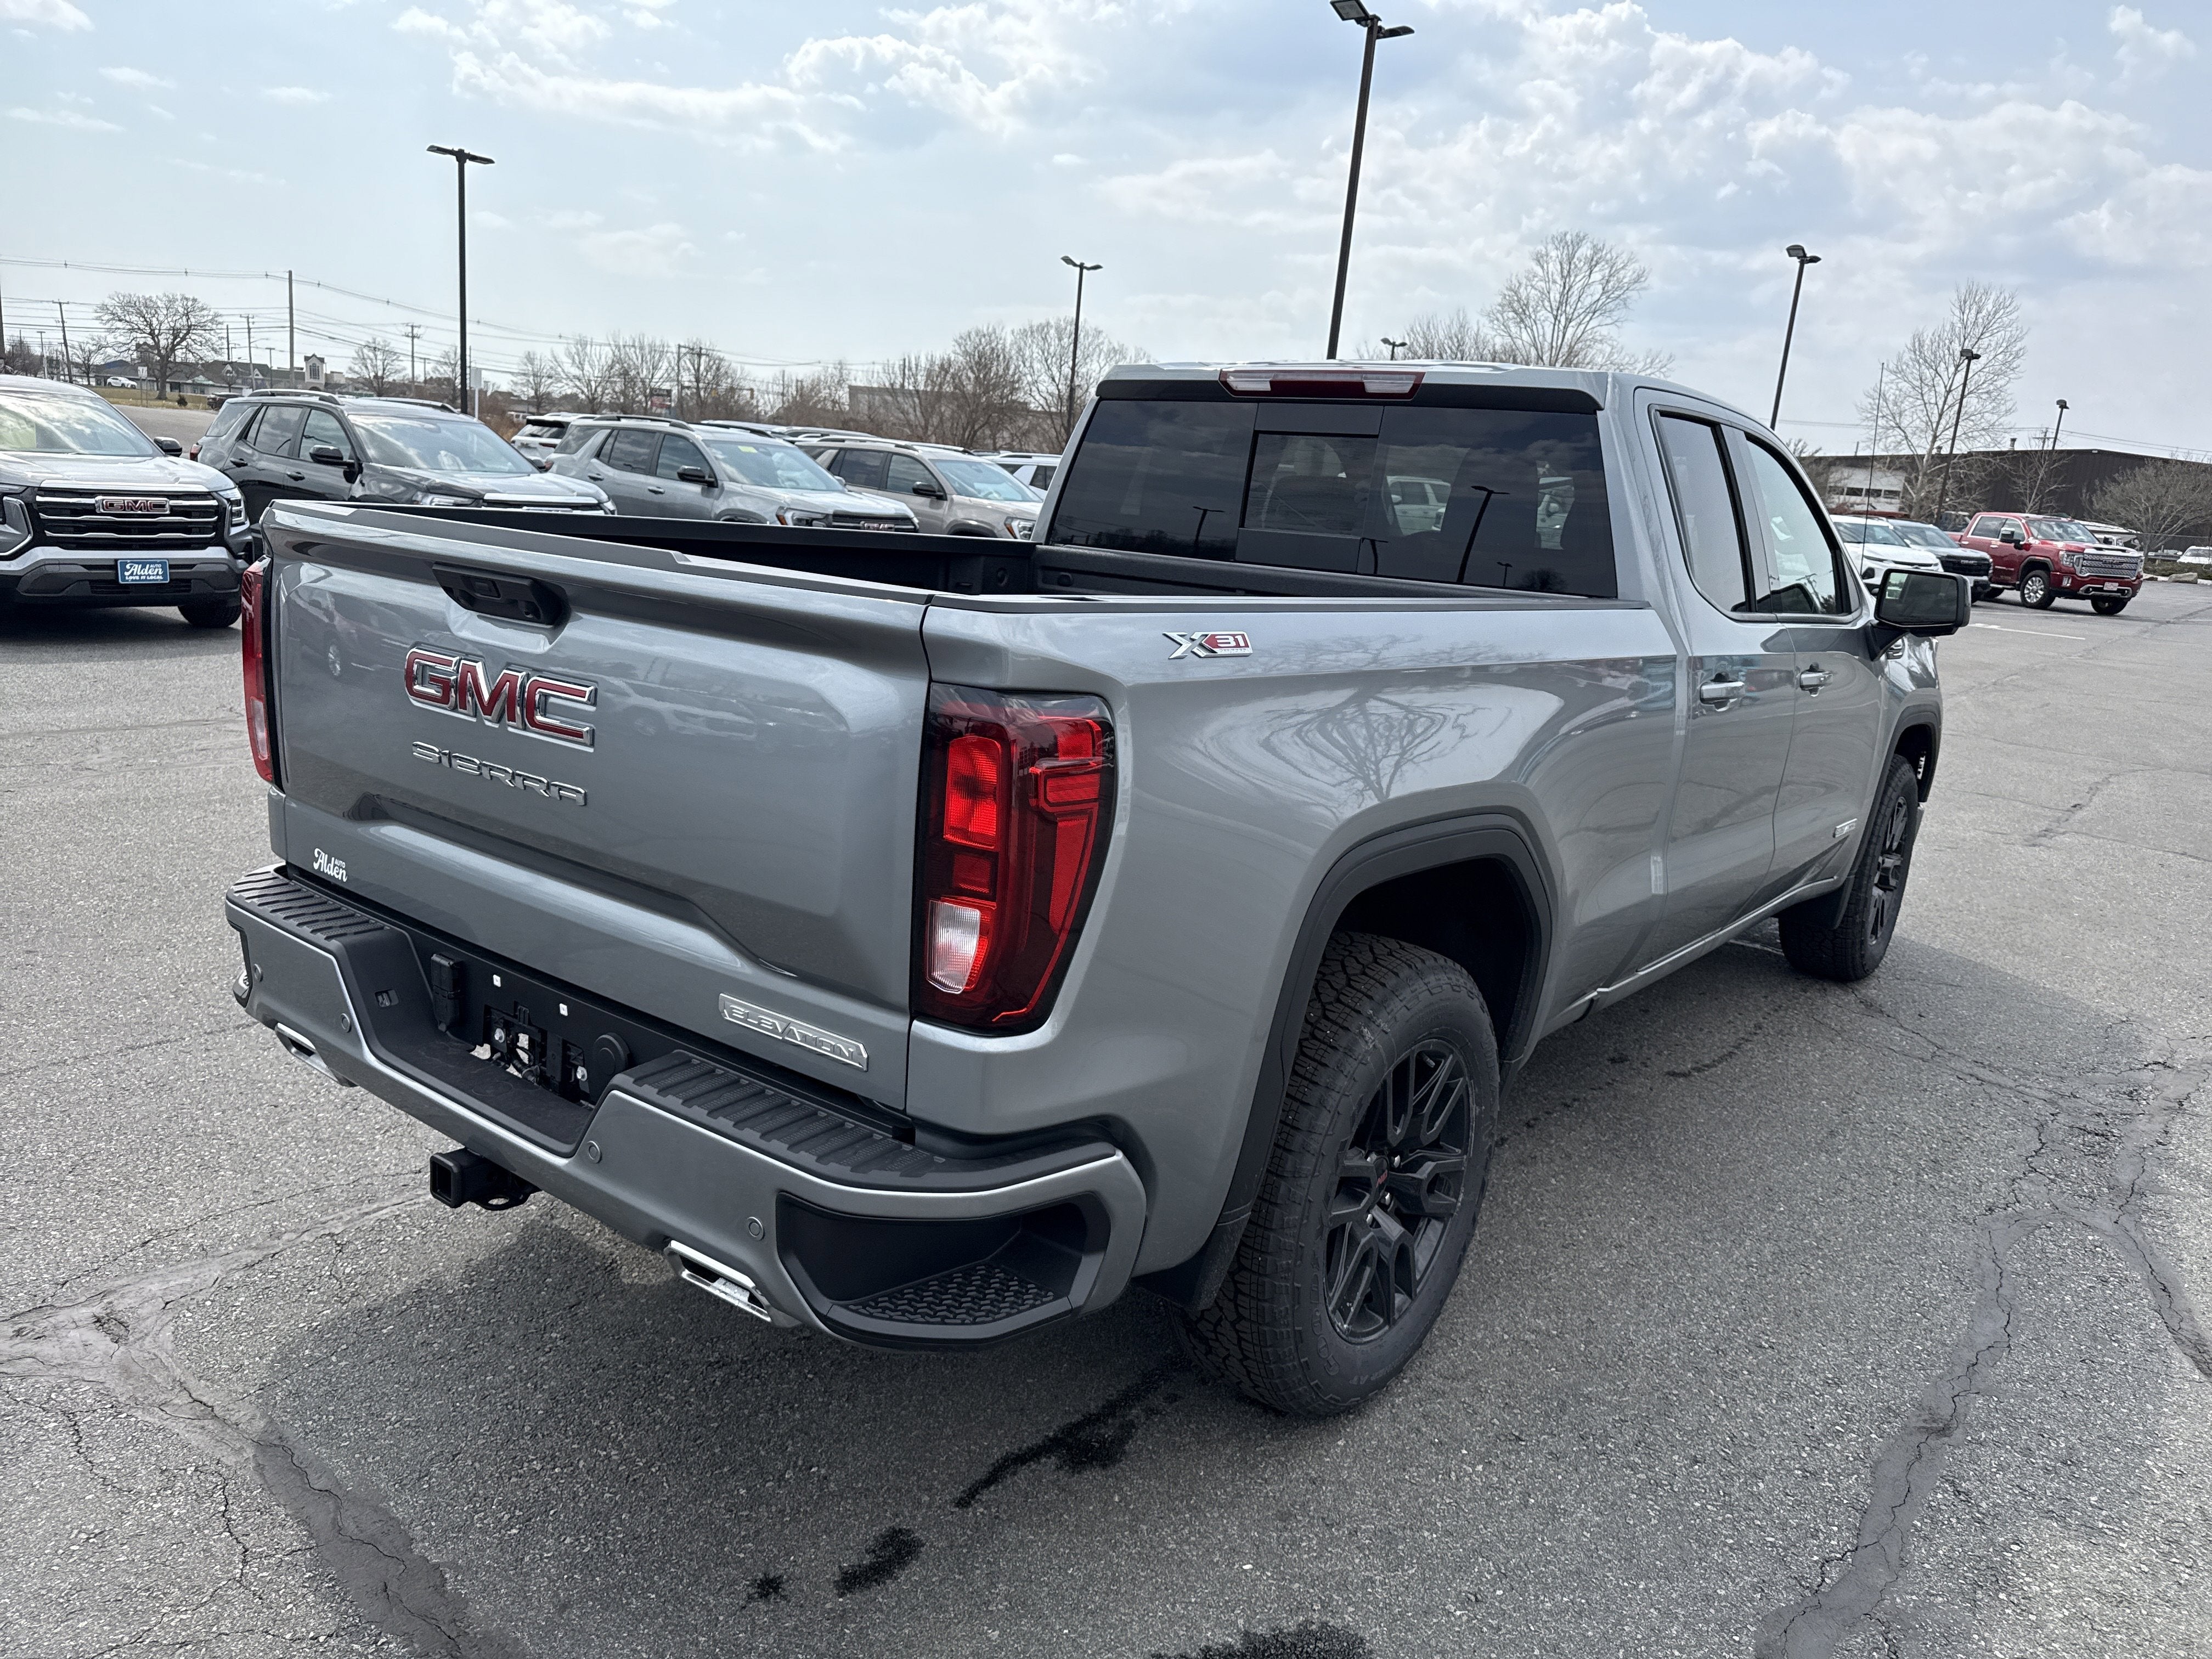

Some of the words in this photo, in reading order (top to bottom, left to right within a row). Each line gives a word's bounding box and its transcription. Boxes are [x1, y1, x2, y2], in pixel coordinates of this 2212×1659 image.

[103, 499, 167, 512] GMC
[124, 563, 164, 576] Alden
[404, 646, 598, 747] GMC
[412, 741, 588, 806] SIERRA
[313, 848, 348, 882] Alden
[334, 858, 346, 868] AUTO
[727, 1004, 857, 1060] ELEVATION
